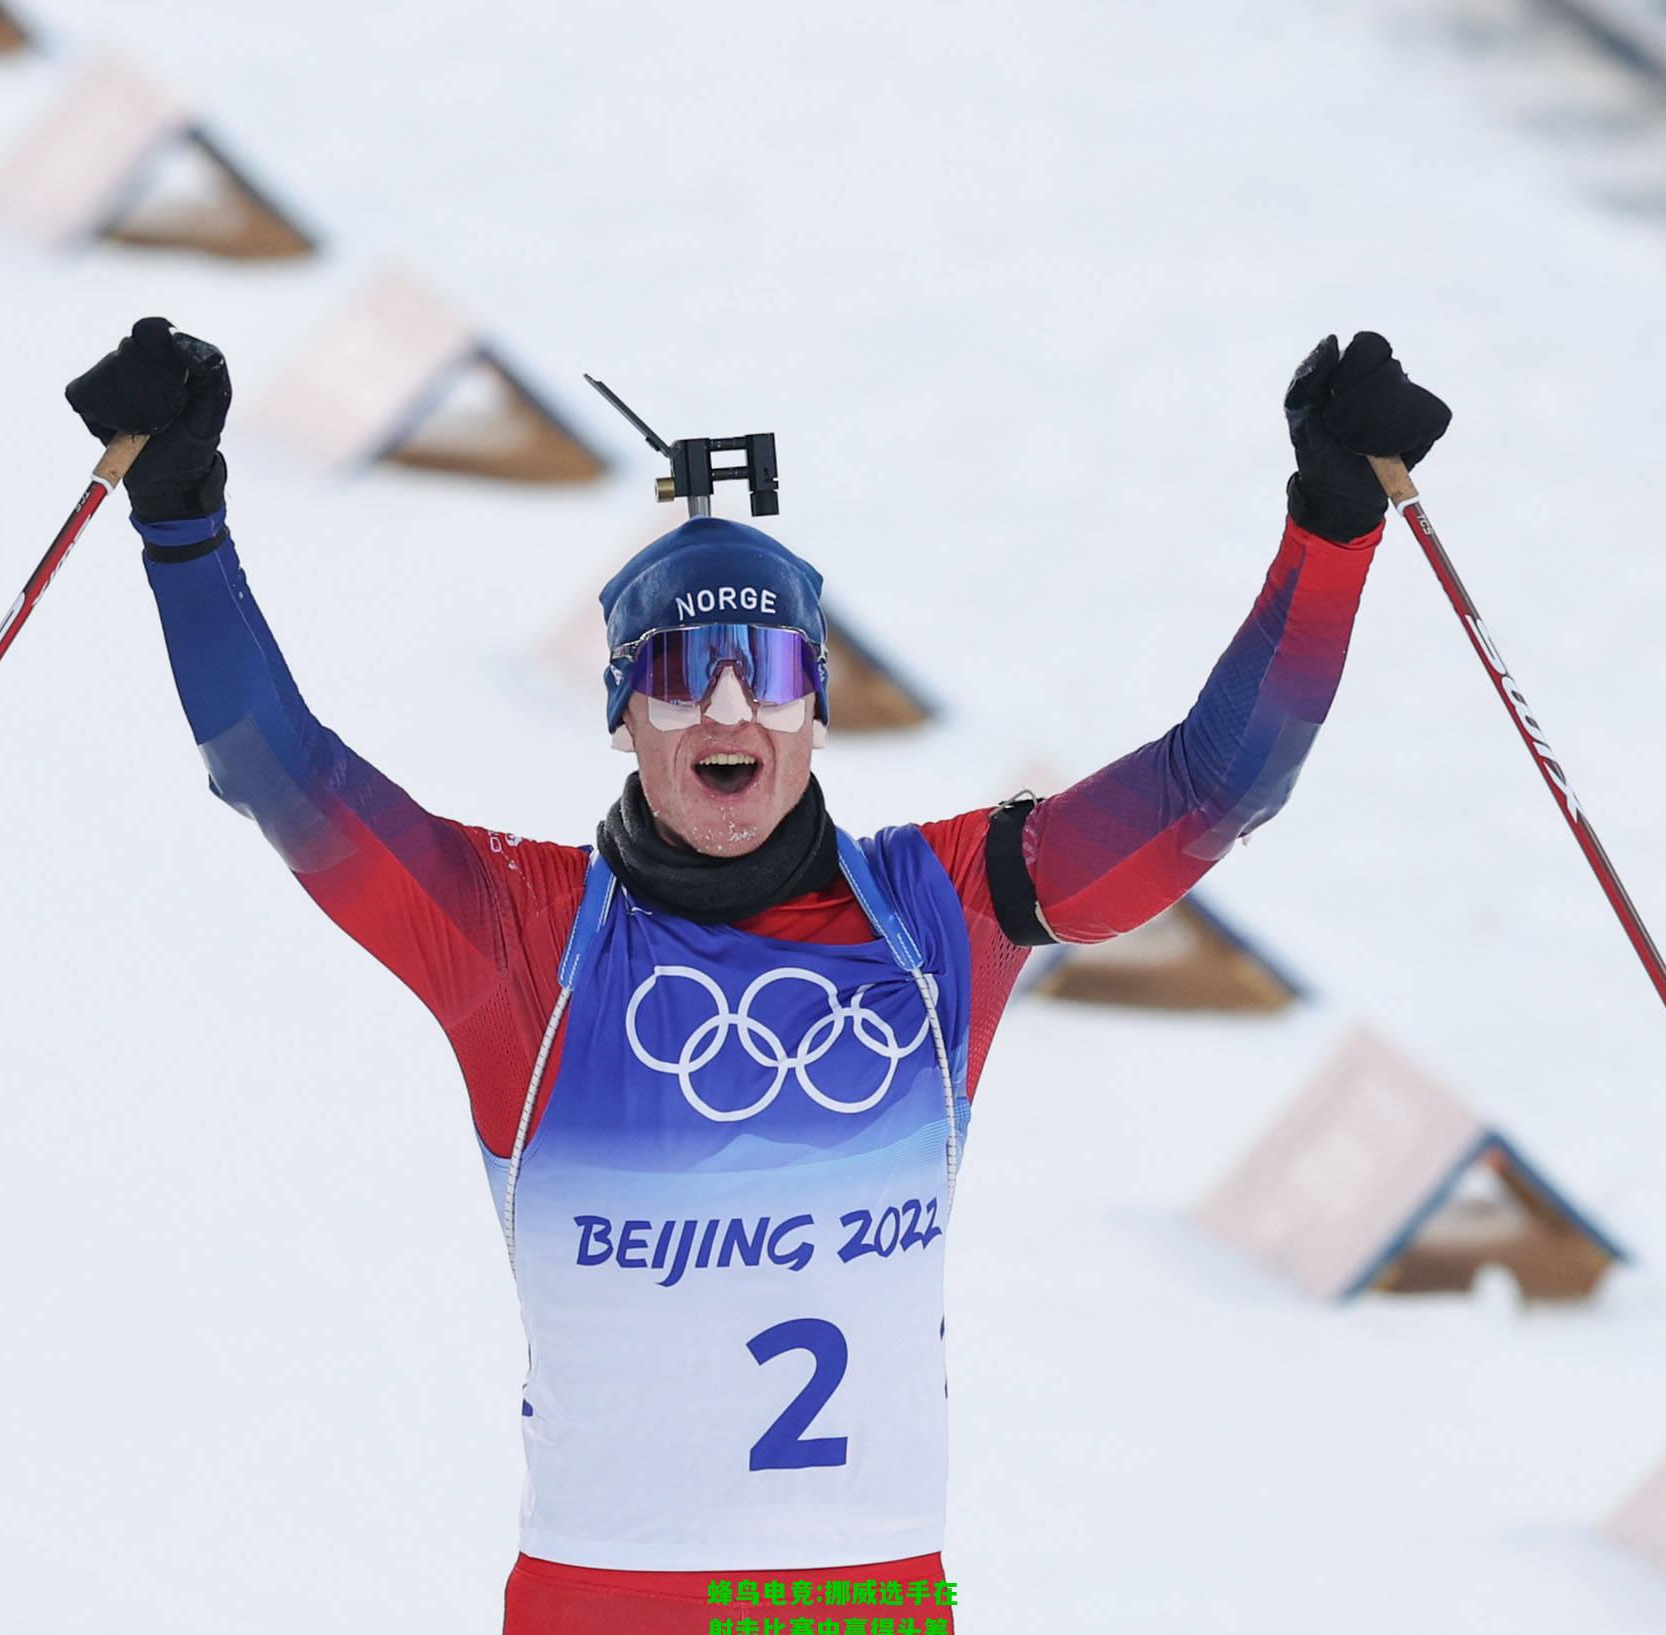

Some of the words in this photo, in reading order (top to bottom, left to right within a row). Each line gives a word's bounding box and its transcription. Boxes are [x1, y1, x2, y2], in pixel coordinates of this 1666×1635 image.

[675, 587, 777, 621] NORGE
[573, 1215, 815, 1288] BEIJING
[839, 1197, 942, 1264] 2022
[746, 1318, 849, 1471] 2
